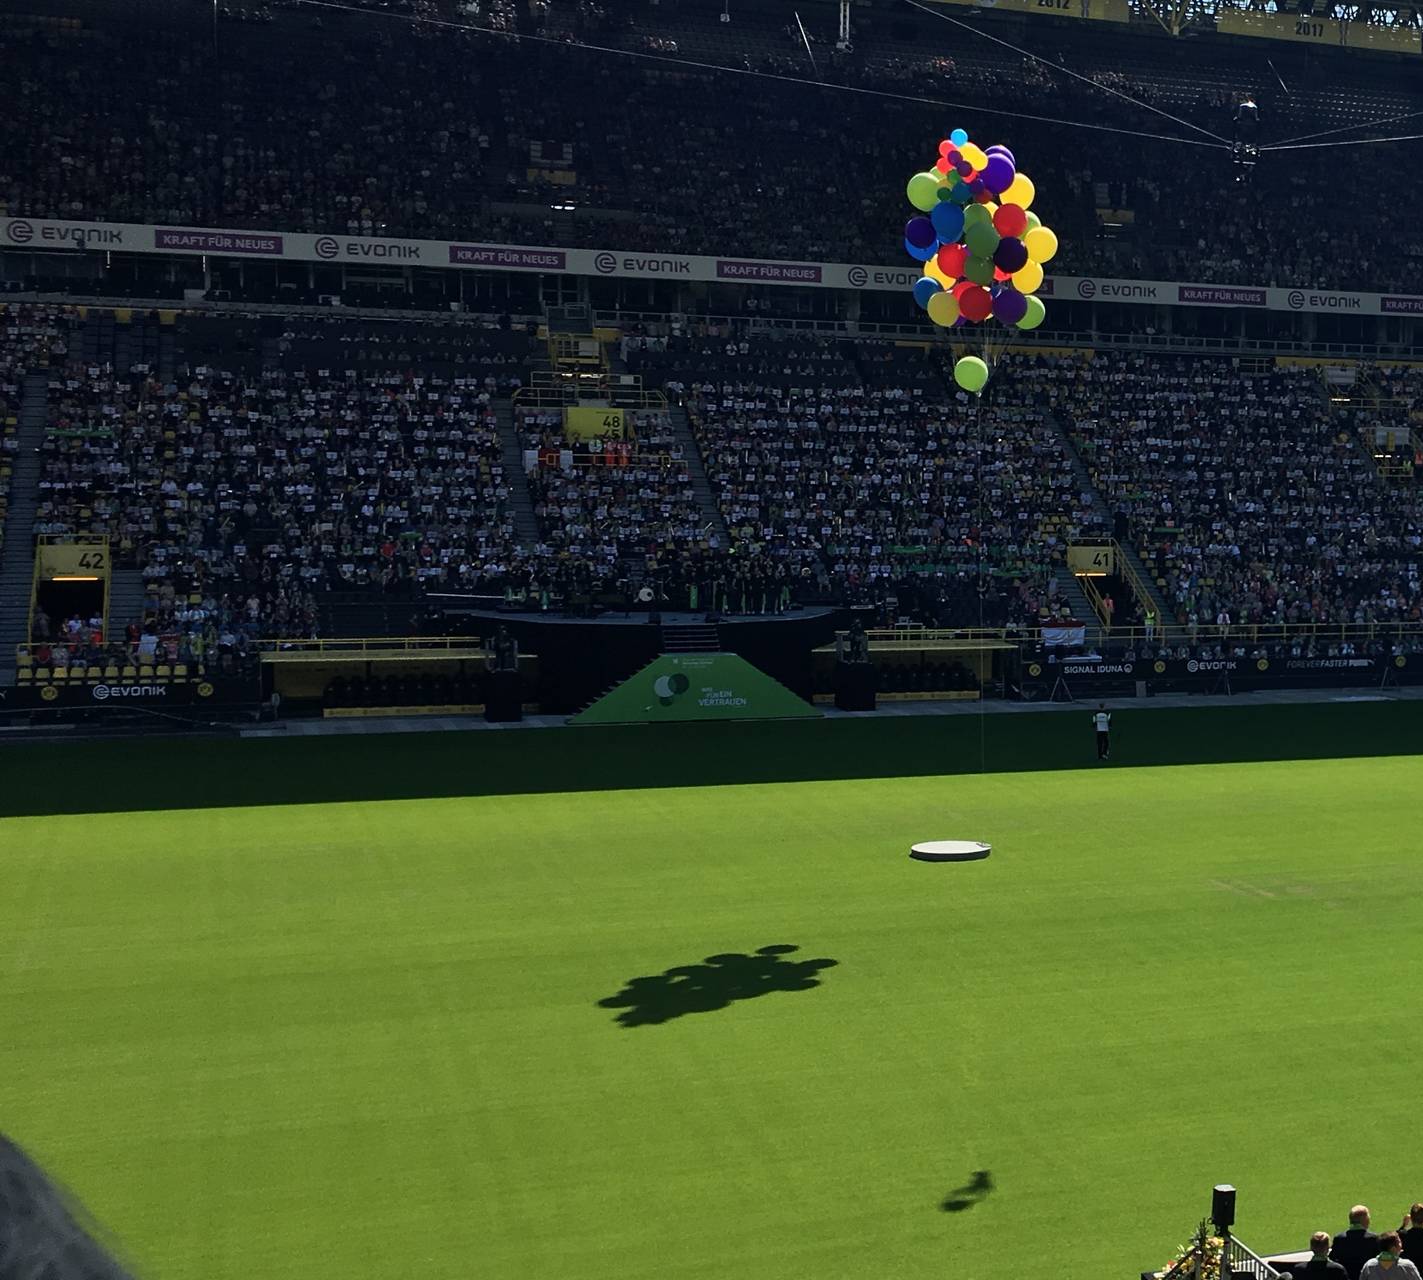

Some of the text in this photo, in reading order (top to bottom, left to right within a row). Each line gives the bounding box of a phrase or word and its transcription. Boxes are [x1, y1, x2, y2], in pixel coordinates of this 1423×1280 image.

[1296, 22, 1323, 37] 2017
[42, 226, 123, 243] EVONIK
[163, 234, 275, 249] KRAFT FÜR NEUES
[347, 243, 420, 258] EVONIK
[457, 250, 559, 265] KRAFT FÜR NEUES
[623, 258, 690, 273] EVONIK
[723, 264, 815, 280] KRAFT FÜR NEUES
[874, 272, 919, 285] EVON
[1101, 286, 1157, 298] EVONIK
[1184, 289, 1261, 302] KRAFT FÜR NEUES
[1310, 295, 1360, 308] EVONIK
[1385, 301, 1413, 311] KRAFT
[603, 415, 620, 427] 48
[79, 553, 104, 569] 42
[1093, 553, 1108, 567] 41
[1064, 664, 1123, 674] SIGNAL IDUNA
[1199, 661, 1237, 670] EVONIK
[111, 686, 166, 697] EVONIK
